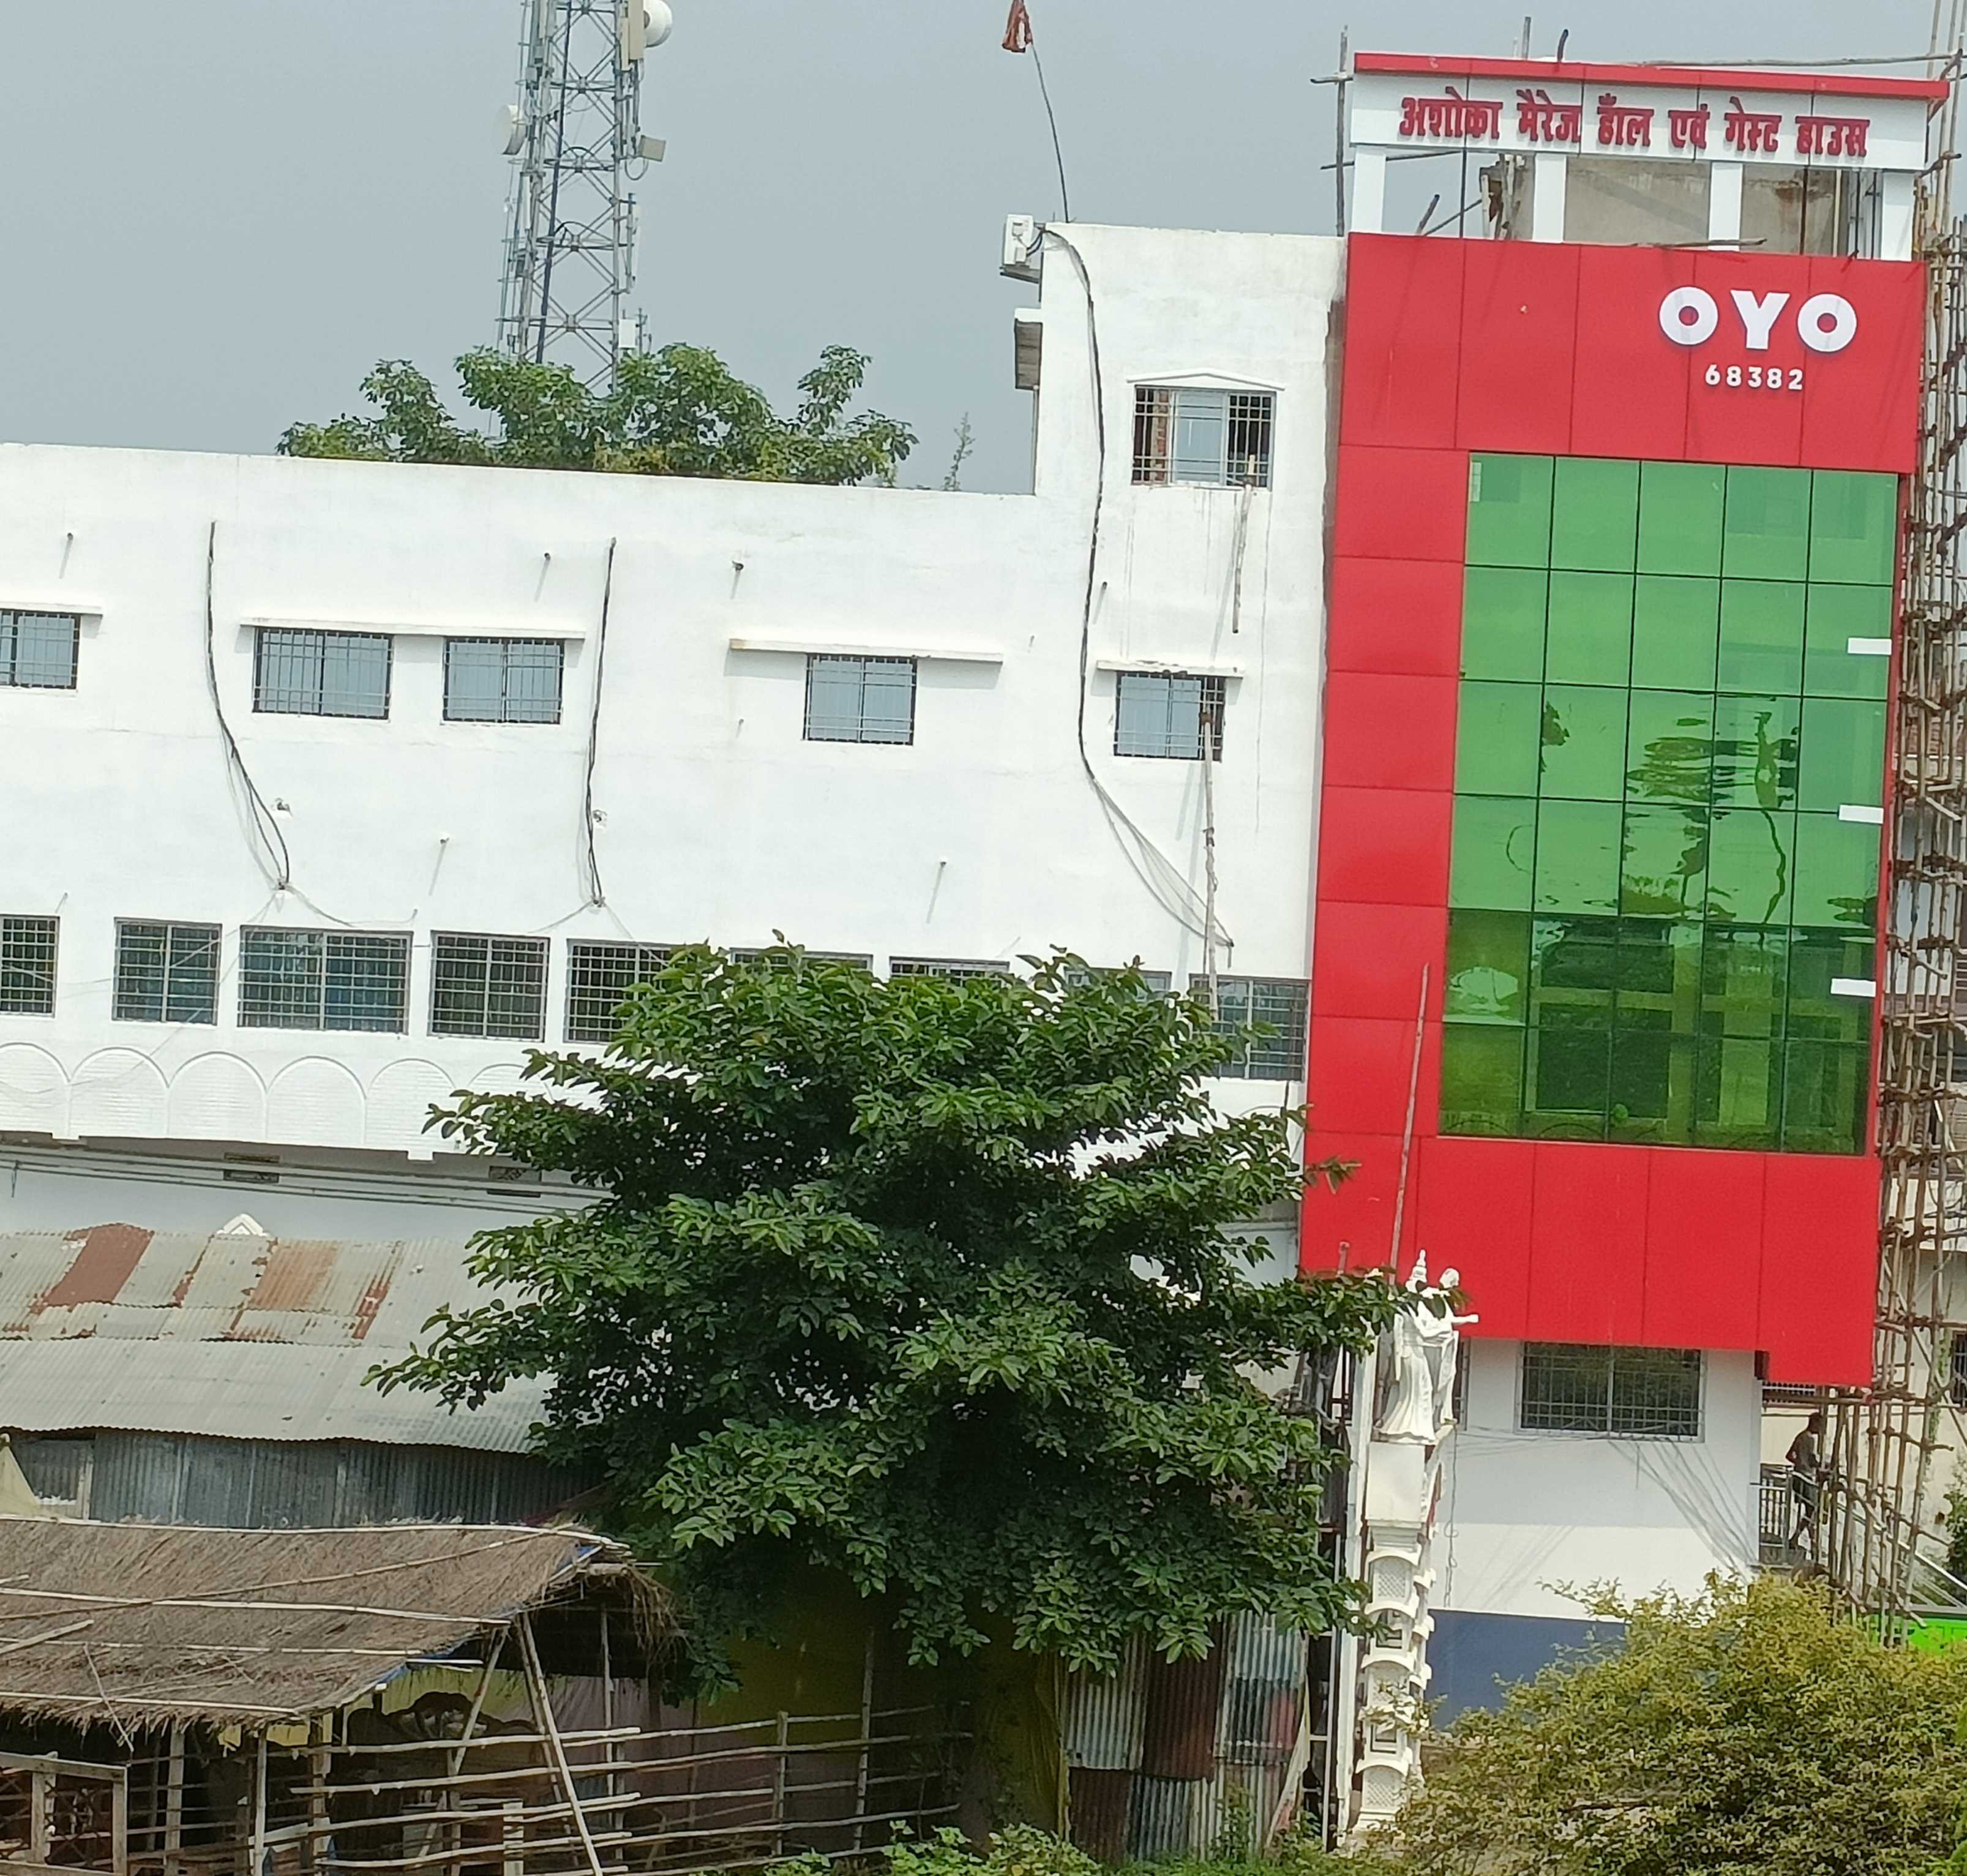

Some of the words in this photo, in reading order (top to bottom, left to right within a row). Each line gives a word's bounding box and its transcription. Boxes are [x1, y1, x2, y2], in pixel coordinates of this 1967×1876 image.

[1399, 86, 1503, 140] अशोका
[1668, 103, 1710, 149] एवं
[1724, 96, 1782, 152] गेस्ट
[1794, 115, 1870, 157] हाउस
[1658, 285, 1857, 353] OYO
[1705, 364, 1804, 391] 68382
